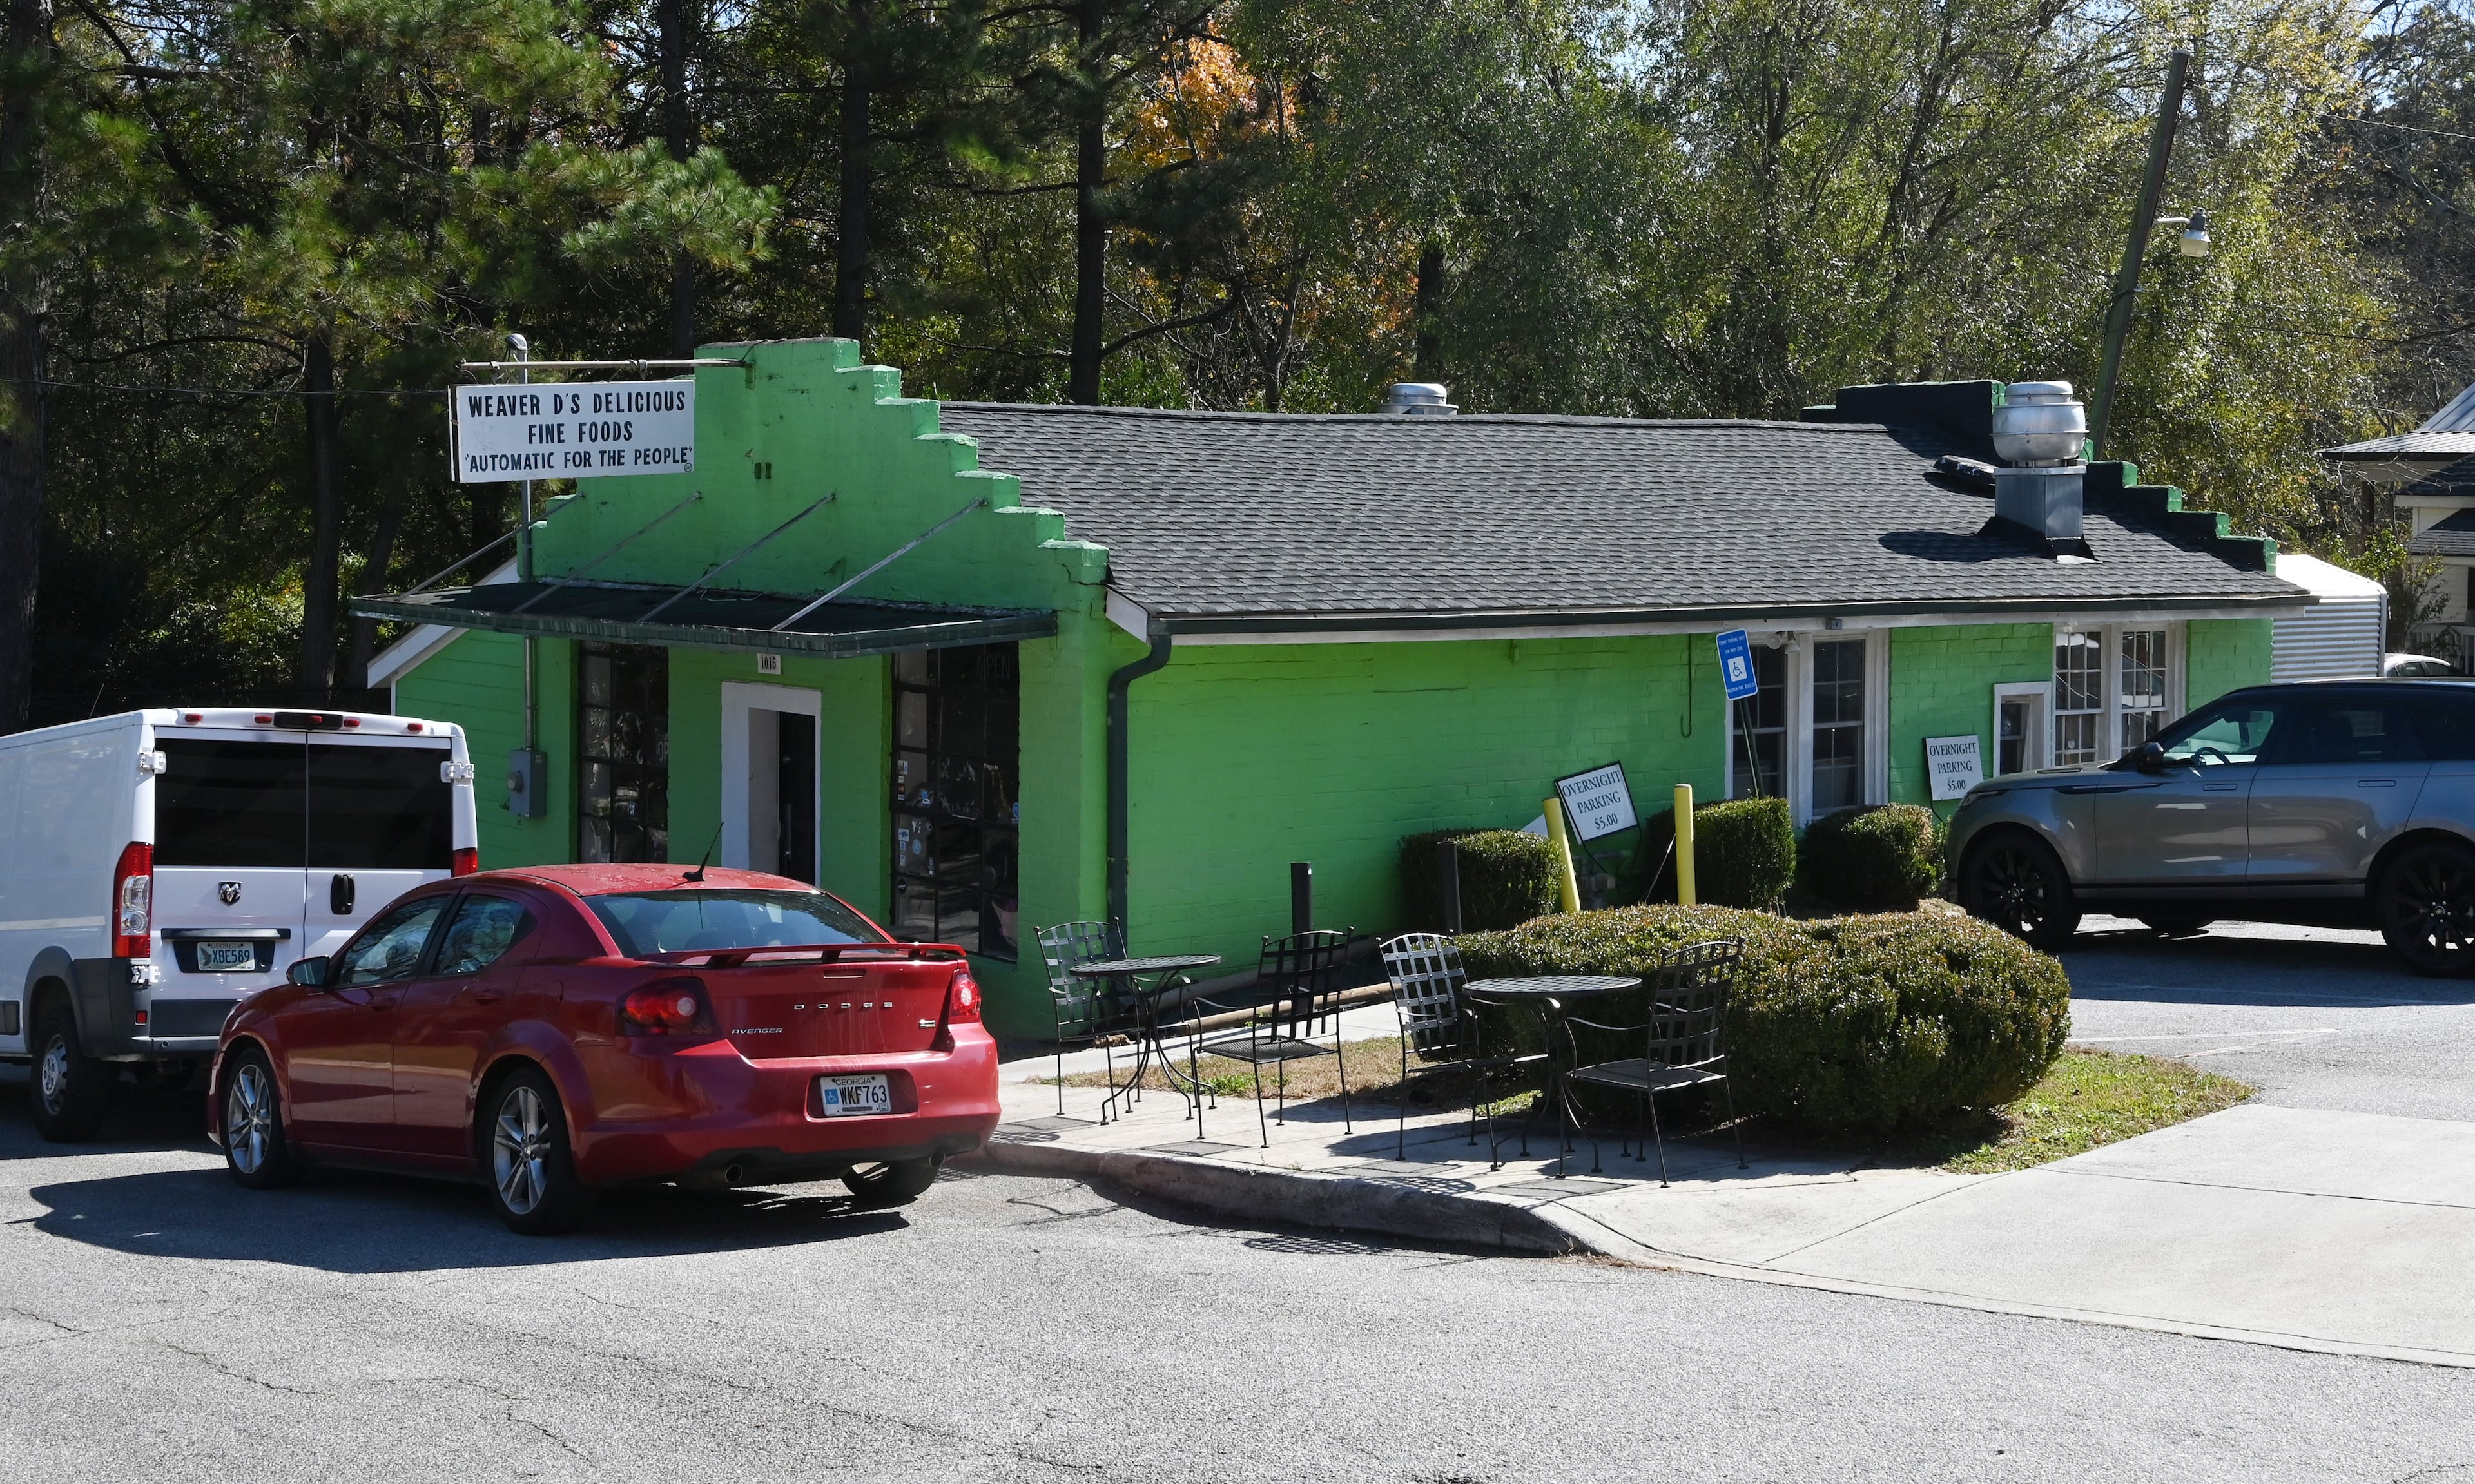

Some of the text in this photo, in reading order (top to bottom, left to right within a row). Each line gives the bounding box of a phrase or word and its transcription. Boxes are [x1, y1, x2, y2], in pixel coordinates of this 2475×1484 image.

[469, 391, 685, 417] WEAVER D'S DELICIOUS
[529, 421, 632, 444] FINE FOODS
[564, 450, 592, 468] FOR
[599, 449, 625, 467] THE
[761, 655, 776, 670] 1016
[1930, 742, 1976, 756] OVERNIGHT
[1937, 760, 1972, 773] PARKING
[1562, 770, 1620, 797] OVERNIGHT
[1947, 779, 1966, 791] $5.00
[1577, 791, 1621, 814] PARKING
[1594, 813, 1618, 830] $5.00
[212, 950, 250, 963] XBE589
[839, 1085, 887, 1105] WKF763
